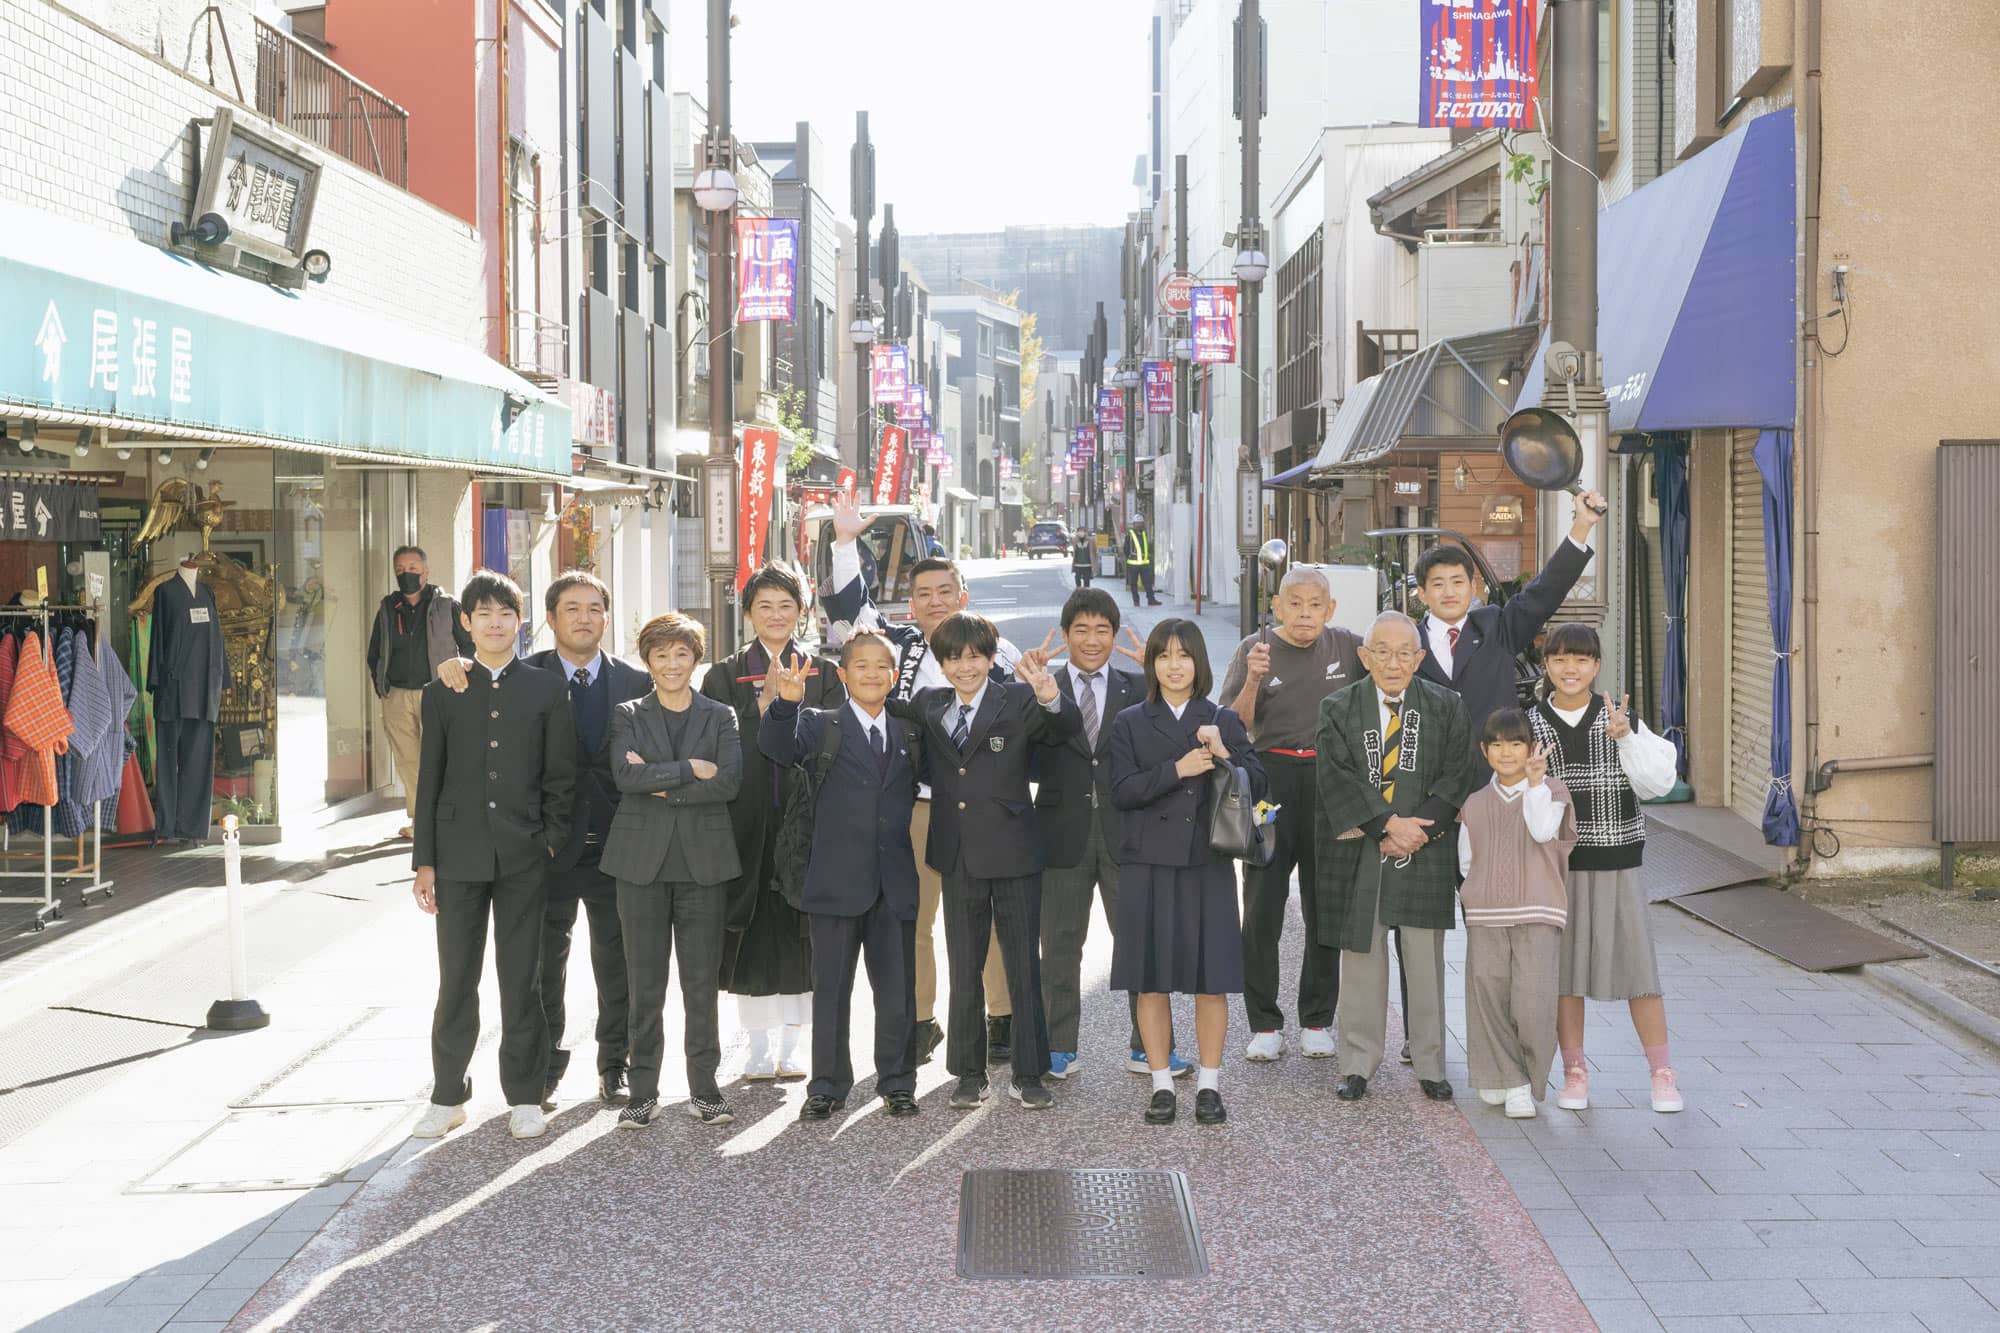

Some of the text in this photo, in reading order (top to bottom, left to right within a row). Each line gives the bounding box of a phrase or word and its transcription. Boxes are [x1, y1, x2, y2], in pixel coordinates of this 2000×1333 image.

[1452, 9, 1513, 20] SHINAGAWA
[243, 162, 300, 233] 尾張屋
[1168, 288, 1191, 301] 消火
[1195, 300, 1232, 317] 品川
[89, 309, 192, 403] 尾張屋
[1147, 371, 1171, 383] 品川
[1101, 397, 1122, 407] 品川
[1400, 709, 1420, 772] 東海道
